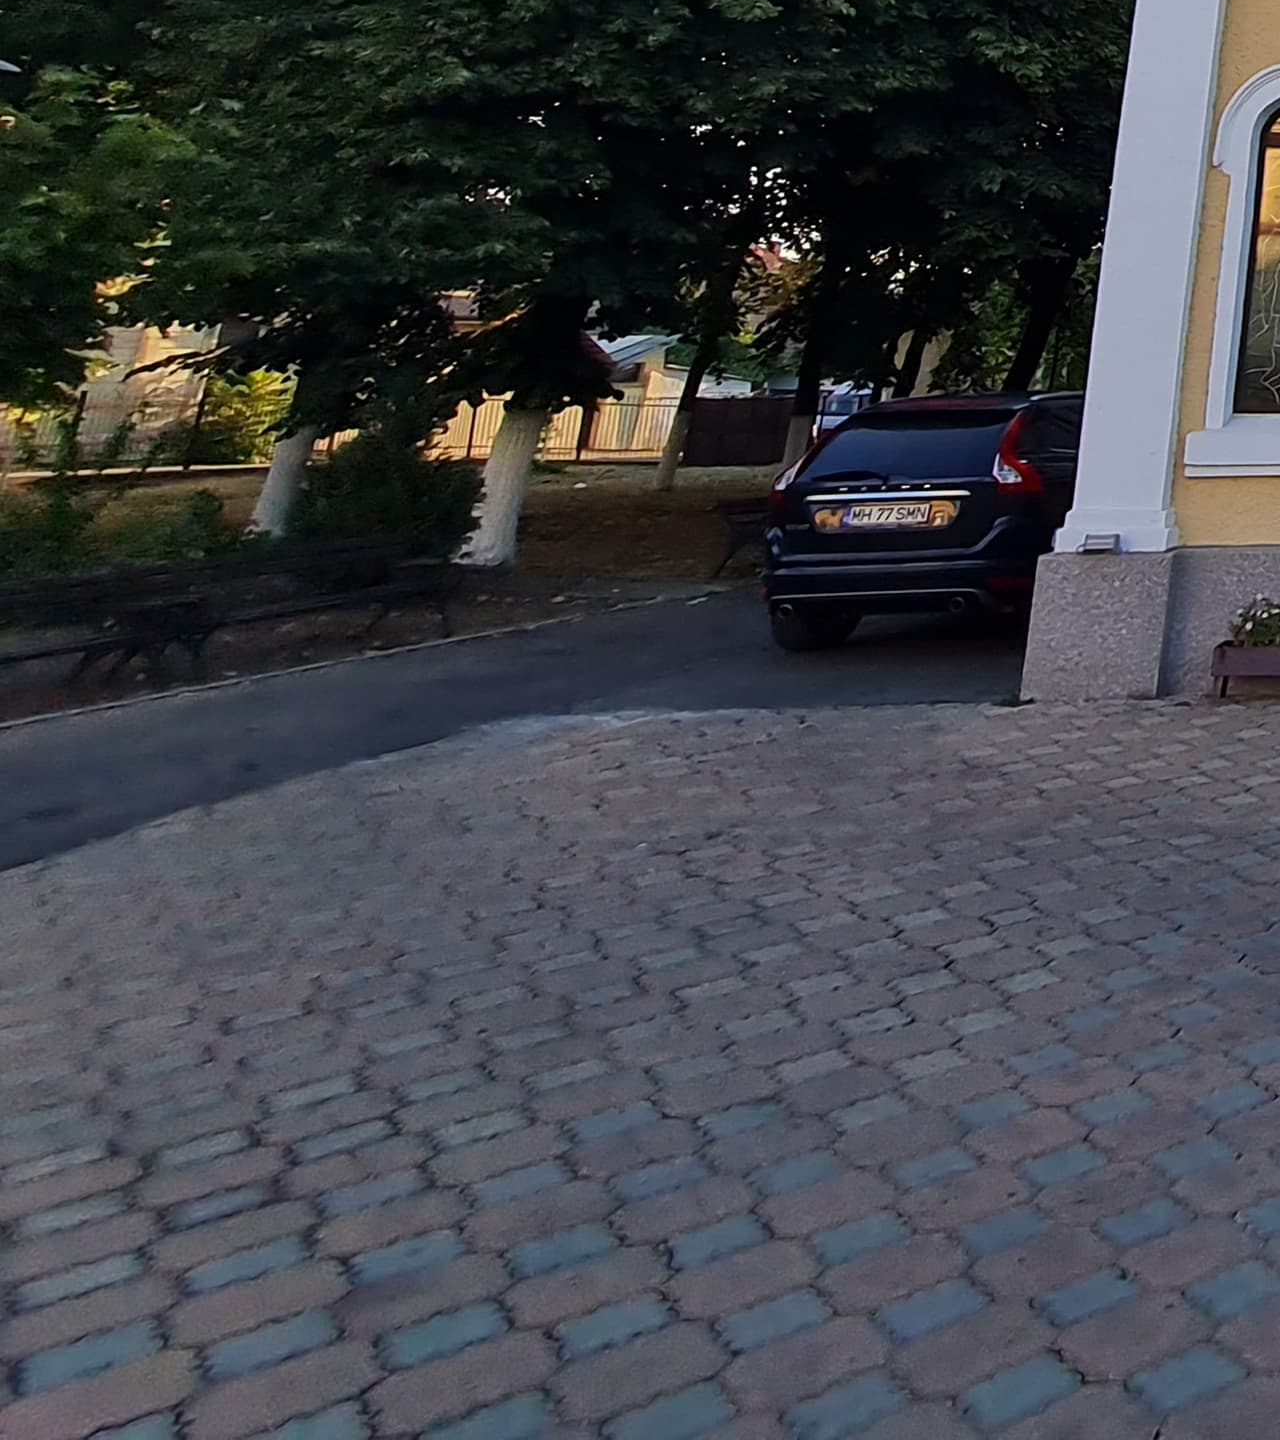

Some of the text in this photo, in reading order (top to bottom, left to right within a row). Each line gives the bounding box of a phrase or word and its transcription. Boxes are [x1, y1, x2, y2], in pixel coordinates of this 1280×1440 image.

[851, 505, 927, 521] MH 77 SMN
